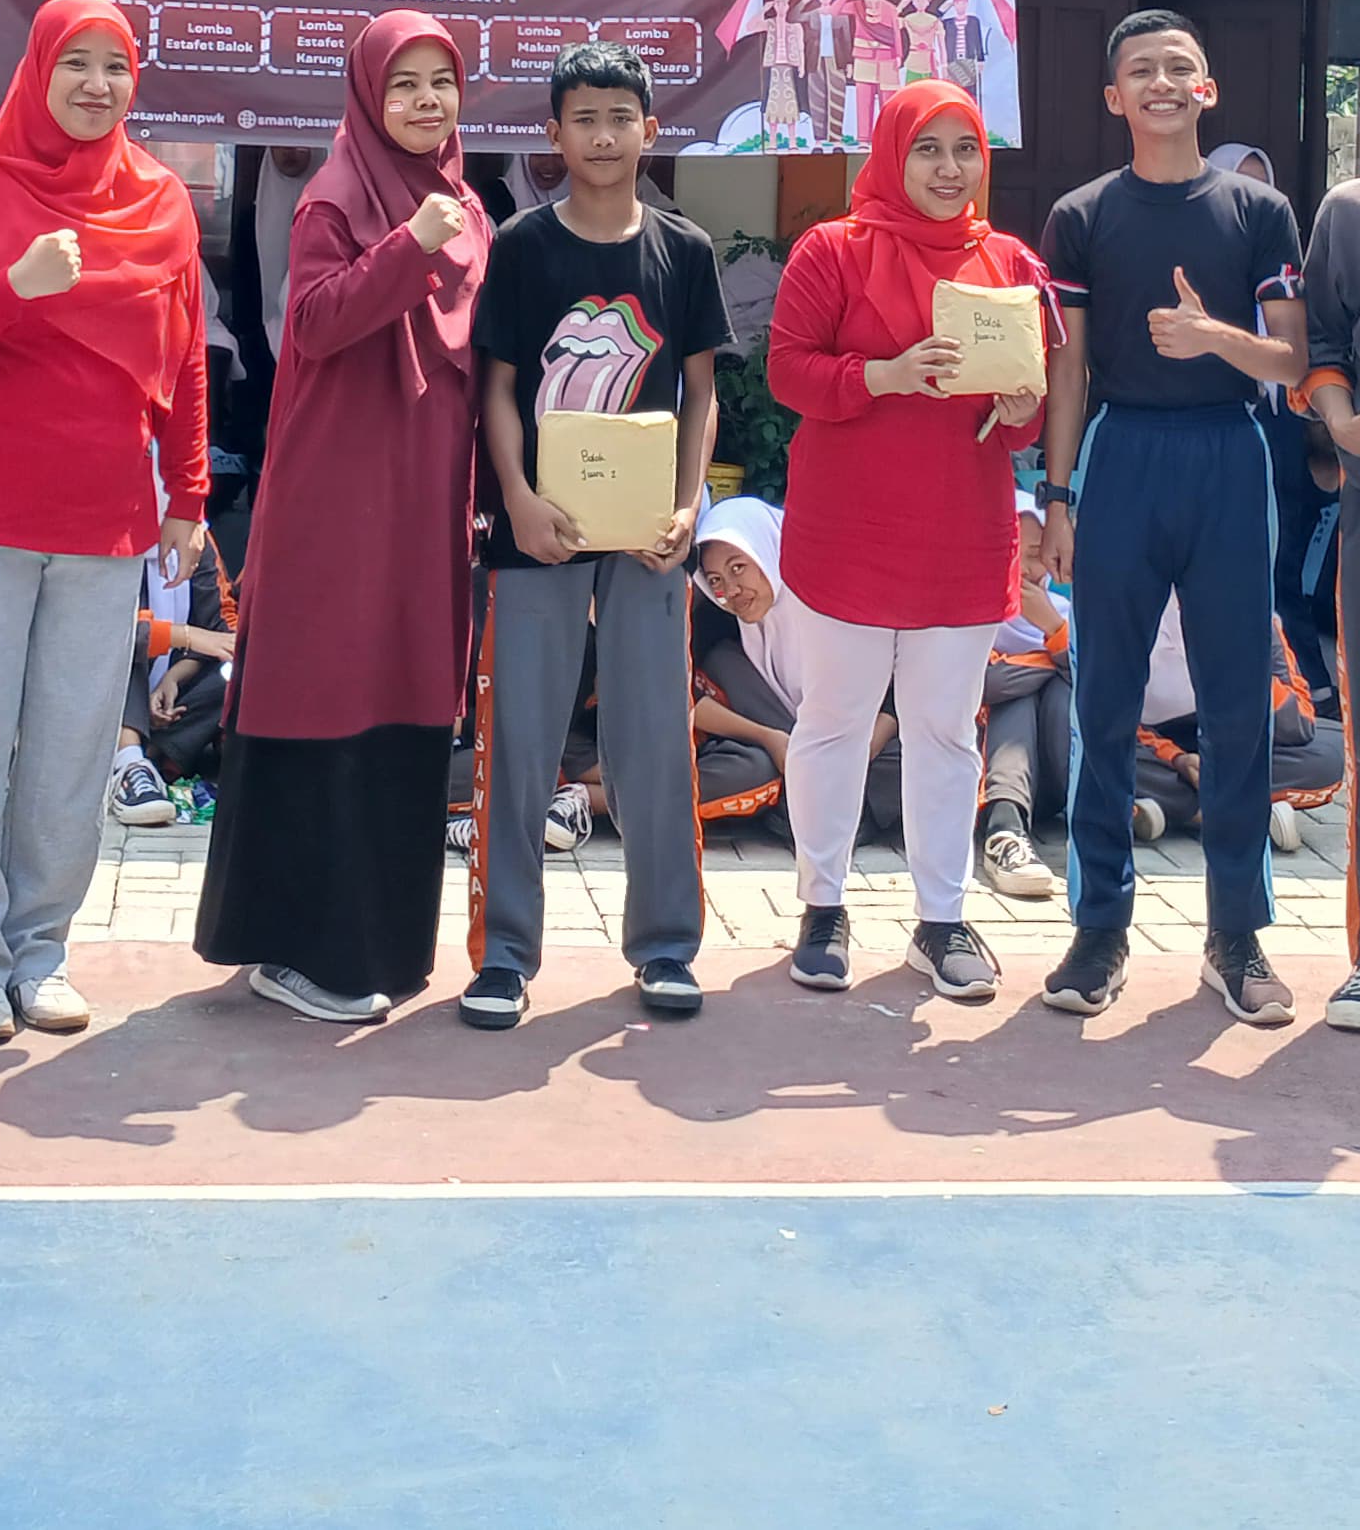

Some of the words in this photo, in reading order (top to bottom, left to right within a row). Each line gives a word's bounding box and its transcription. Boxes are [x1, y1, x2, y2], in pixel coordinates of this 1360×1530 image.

[187, 23, 233, 36] Lomba
[299, 20, 344, 33] Lomba
[517, 25, 561, 37] Lomba
[625, 28, 670, 39] Lomba
[165, 38, 215, 53] Estafet
[217, 40, 254, 54] Balok
[296, 36, 345, 49] Estafet
[517, 41, 560, 53] Makan
[626, 44, 665, 56] Video
[296, 53, 345, 68] Karung
[652, 61, 690, 73] Suara
